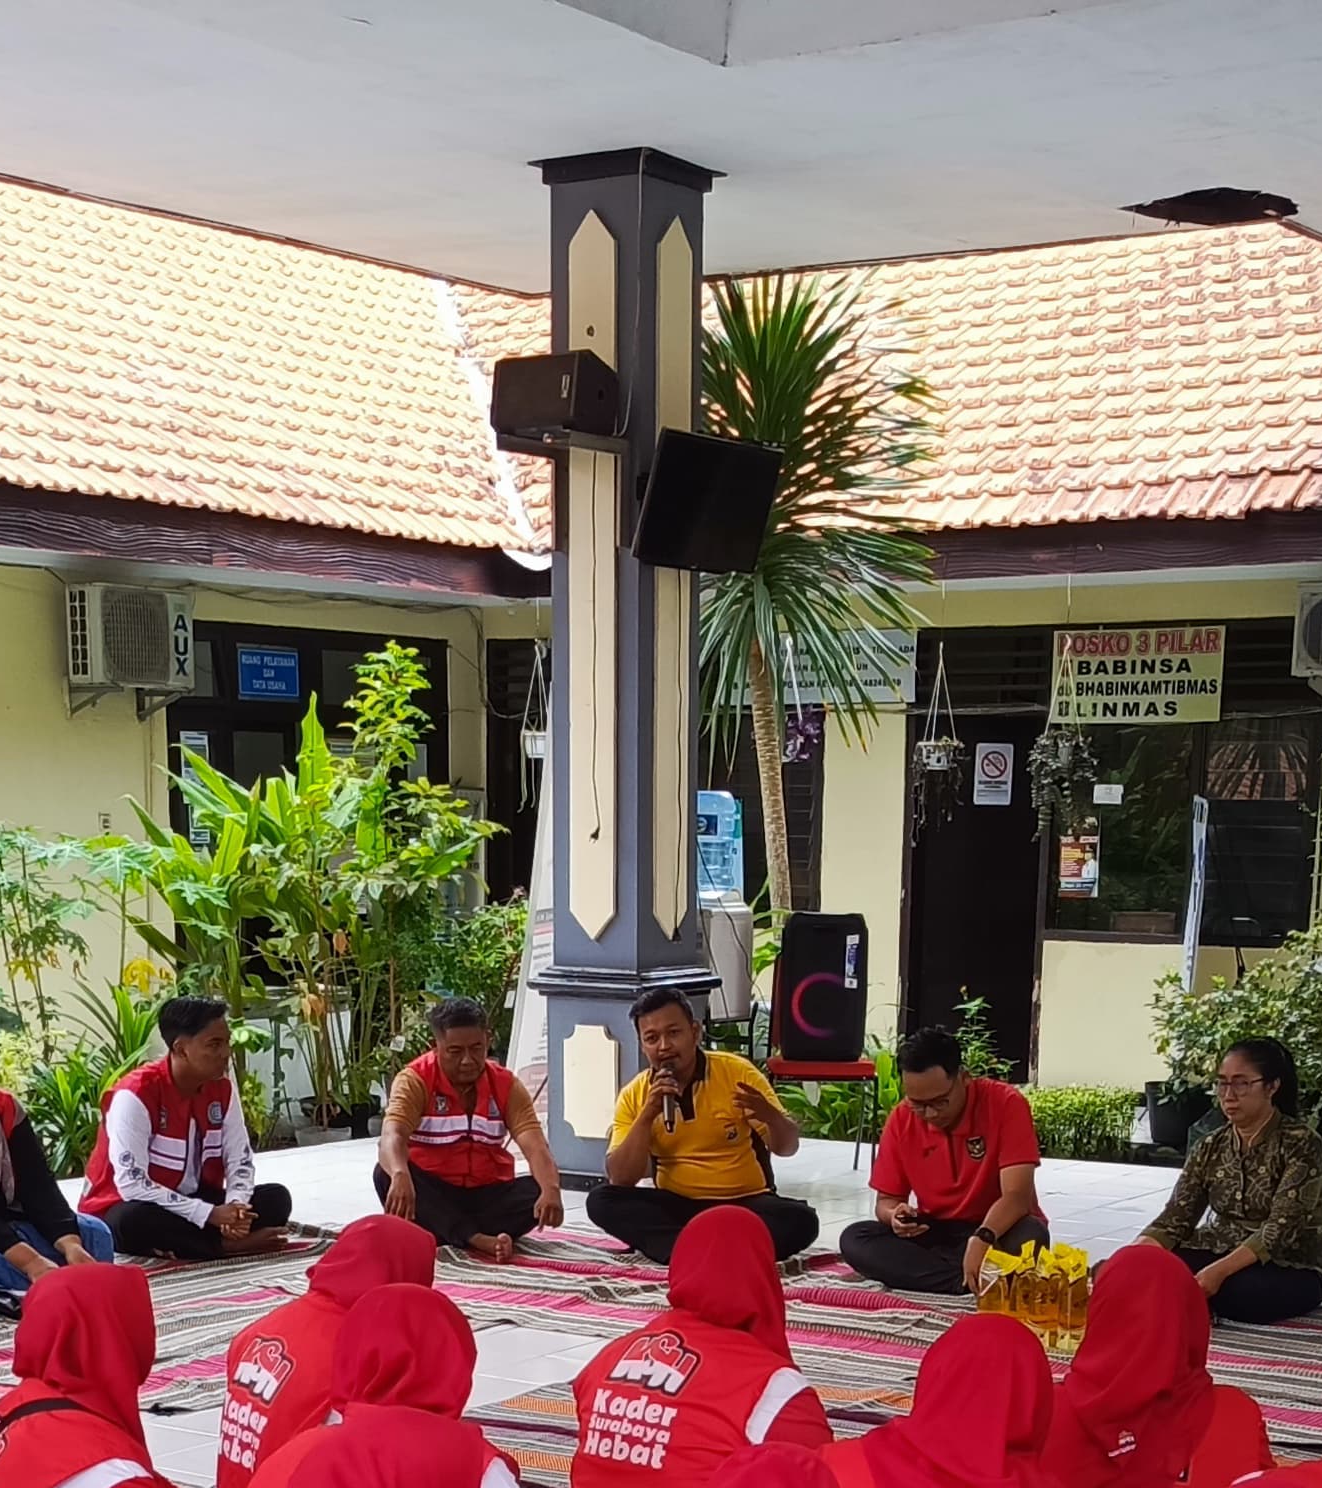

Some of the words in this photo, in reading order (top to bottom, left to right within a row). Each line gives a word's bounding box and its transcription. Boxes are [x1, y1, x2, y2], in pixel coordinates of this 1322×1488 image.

[174, 614, 188, 676] AUX
[1058, 631, 1132, 656] POSKO
[1136, 630, 1150, 654] 3
[1155, 628, 1221, 654] PILAR
[1078, 659, 1191, 675] BABINSA
[1076, 679, 1218, 696] BHABINKAMTIBMAS
[1077, 701, 1177, 717] LINMAS
[592, 1388, 678, 1427] Kader
[589, 1413, 671, 1444] Surabaya
[219, 1434, 256, 1474] eba
[584, 1430, 666, 1469] Hebat
